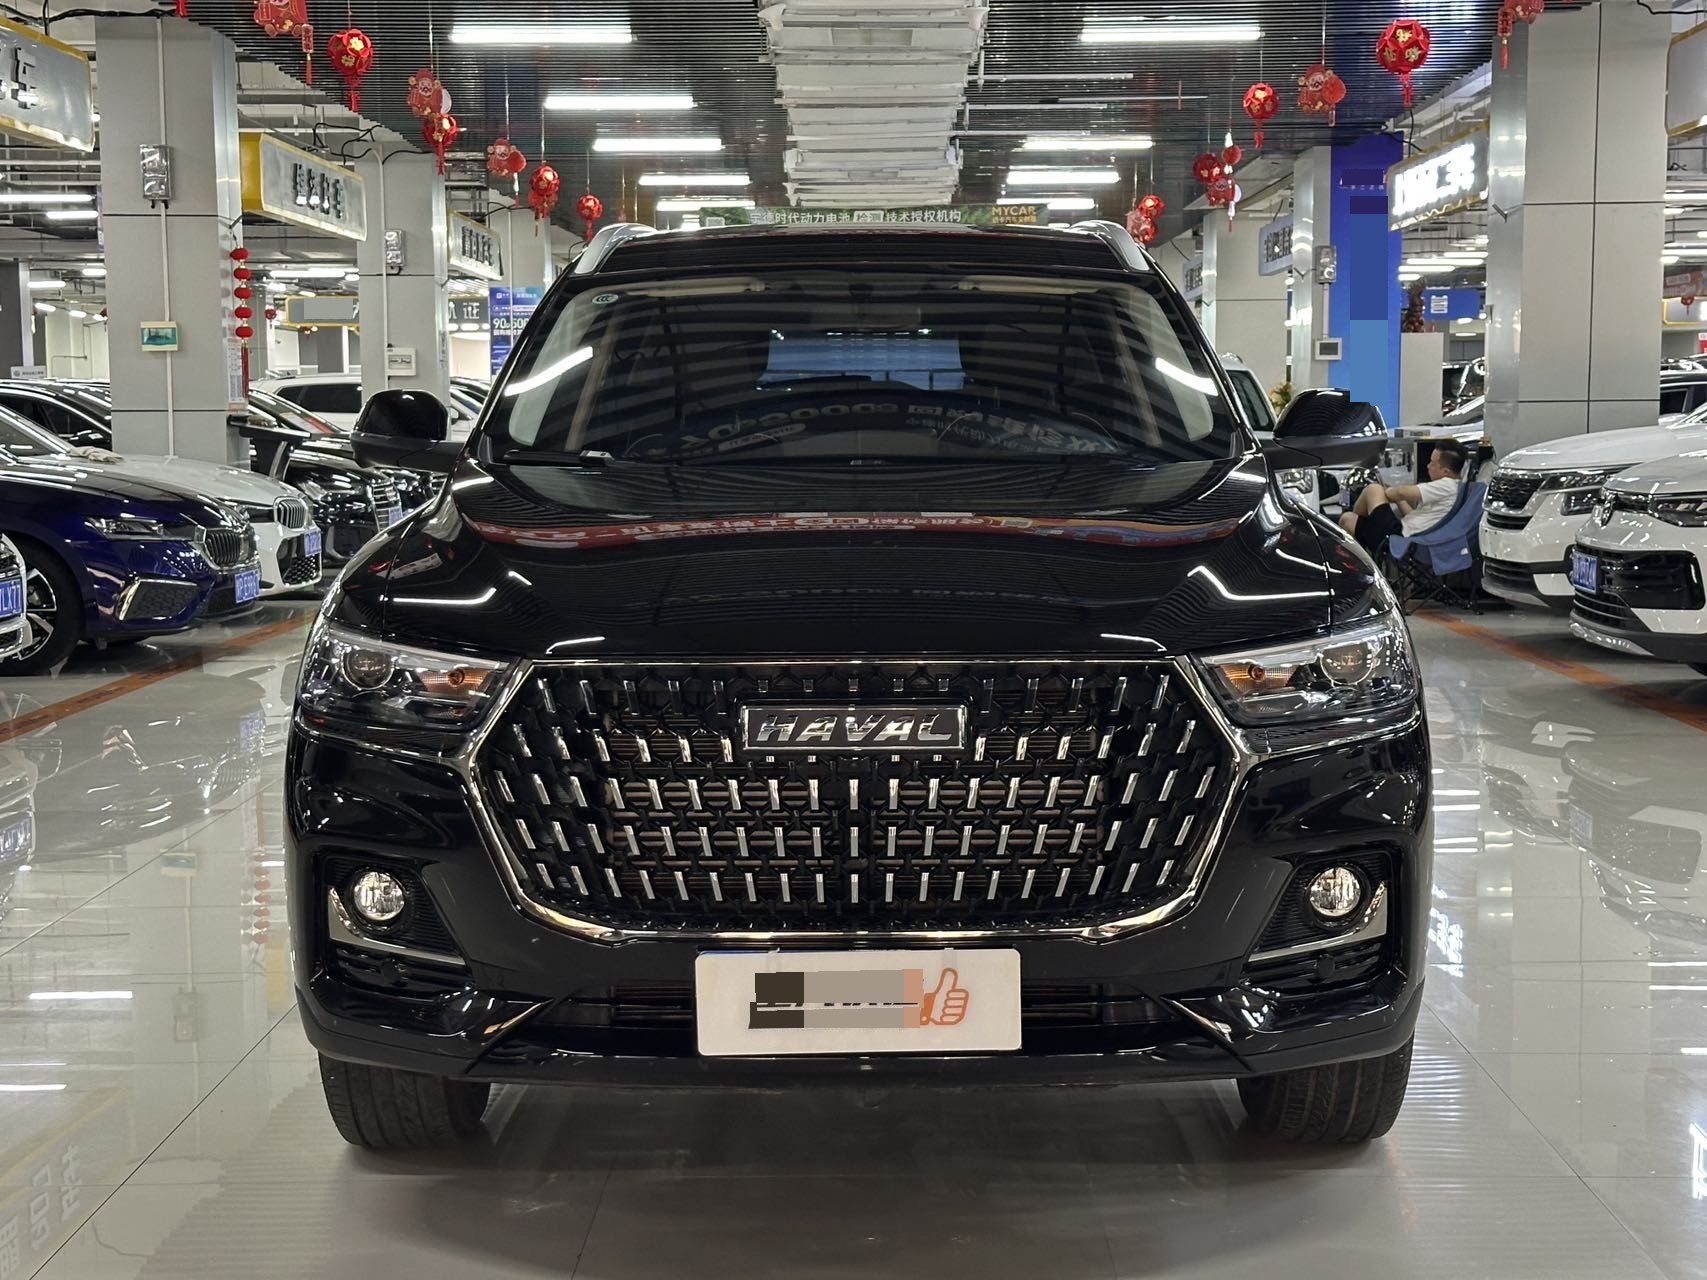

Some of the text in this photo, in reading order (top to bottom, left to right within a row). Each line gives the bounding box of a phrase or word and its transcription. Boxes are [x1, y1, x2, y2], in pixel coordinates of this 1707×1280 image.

[991, 206, 1037, 216] MYCAR
[0, 584, 21, 612] LX77
[755, 713, 953, 743] HAVAL
